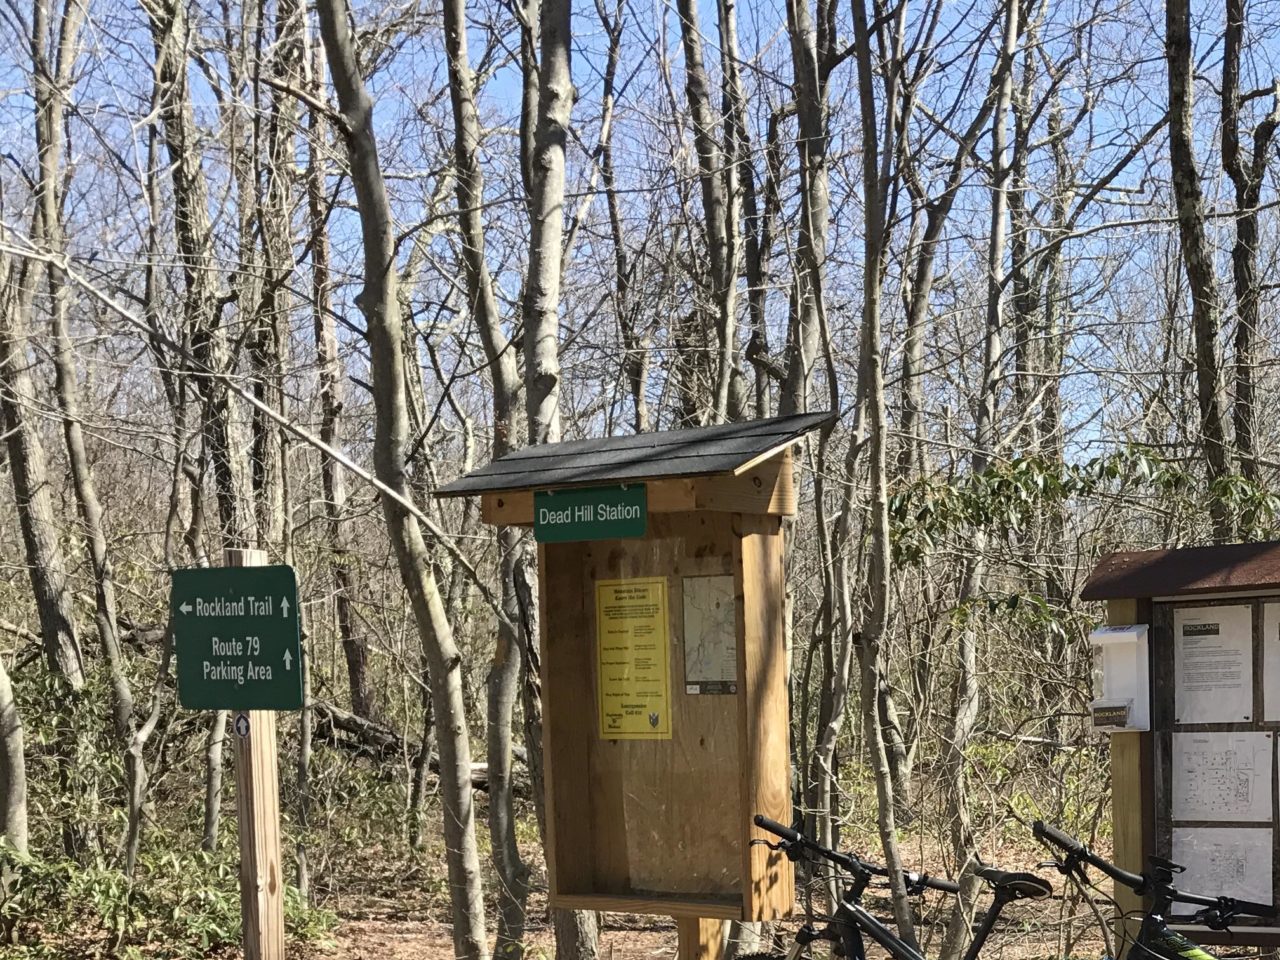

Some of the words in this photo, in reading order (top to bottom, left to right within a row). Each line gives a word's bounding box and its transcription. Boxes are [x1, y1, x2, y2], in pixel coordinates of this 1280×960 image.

[540, 506, 571, 525] Dead
[575, 505, 594, 522] Hill
[597, 502, 640, 521] Station
[196, 596, 245, 617] Rockland
[248, 596, 273, 616] Trail
[212, 637, 243, 656] Route
[245, 636, 260, 656] 79
[203, 661, 245, 685] Parking
[247, 661, 272, 680] Area
